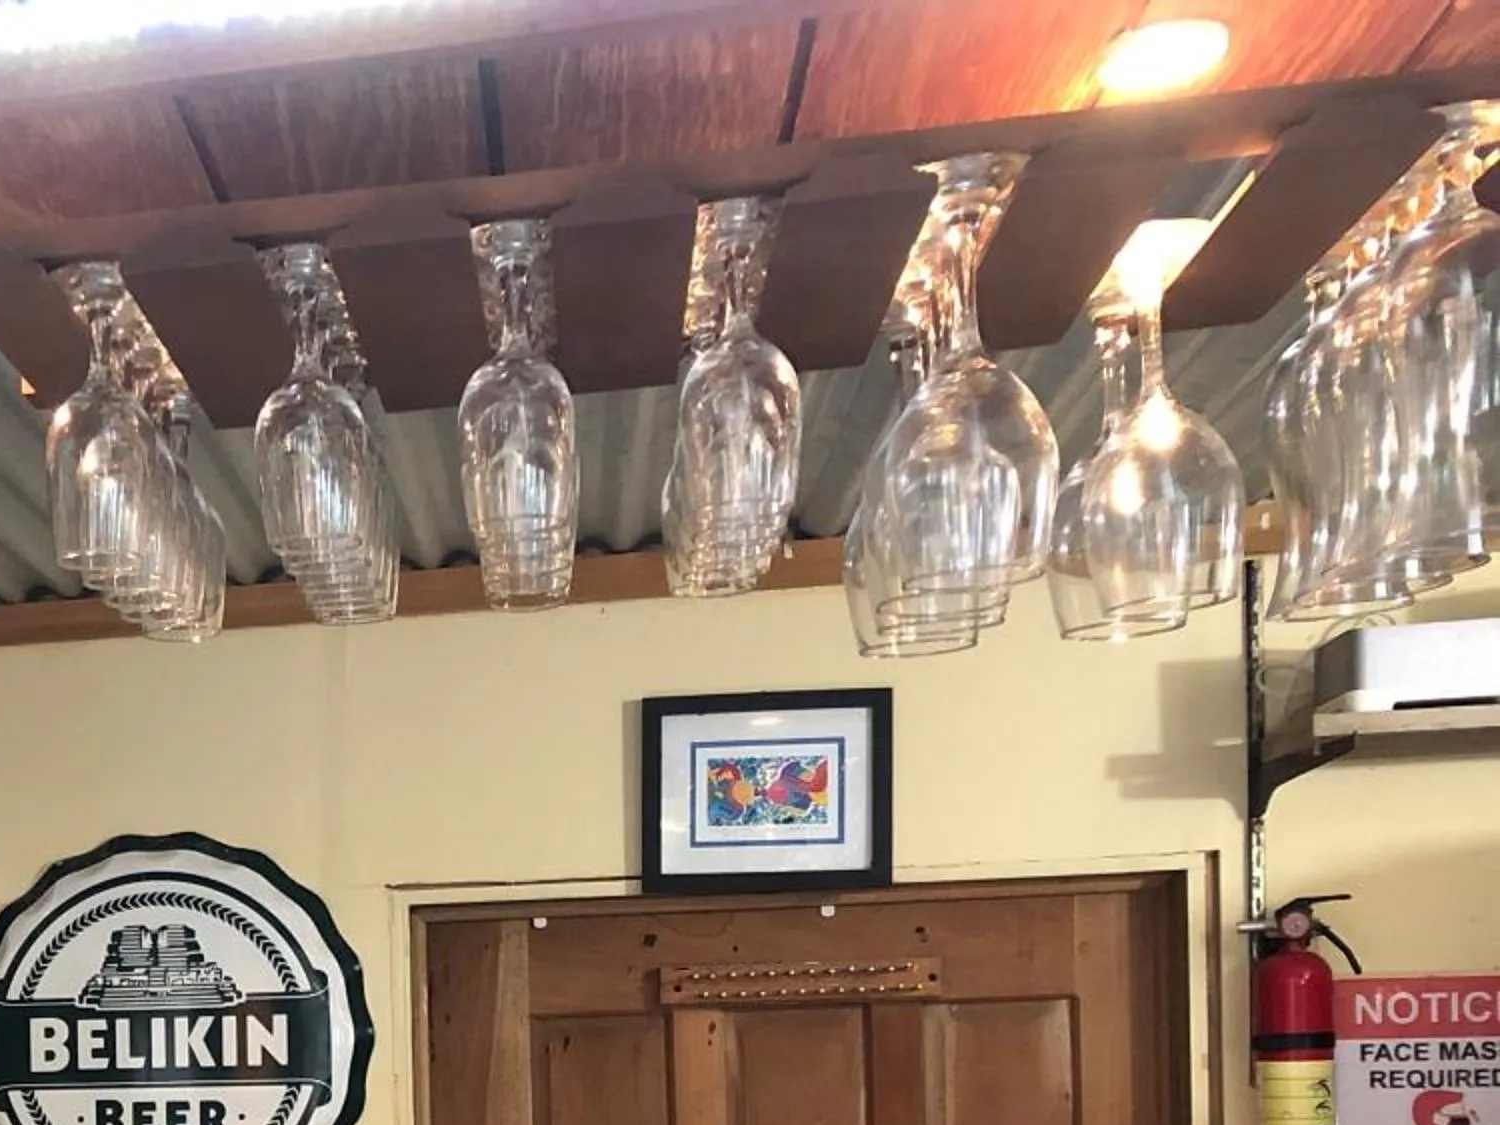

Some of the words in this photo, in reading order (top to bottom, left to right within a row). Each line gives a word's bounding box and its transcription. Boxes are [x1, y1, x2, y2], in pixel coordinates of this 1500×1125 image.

[1355, 991, 1500, 1025] NOTIC
[29, 1014, 288, 1073] BELIKIN
[1360, 1042, 1430, 1062] FACE
[1439, 1041, 1500, 1061] MAS
